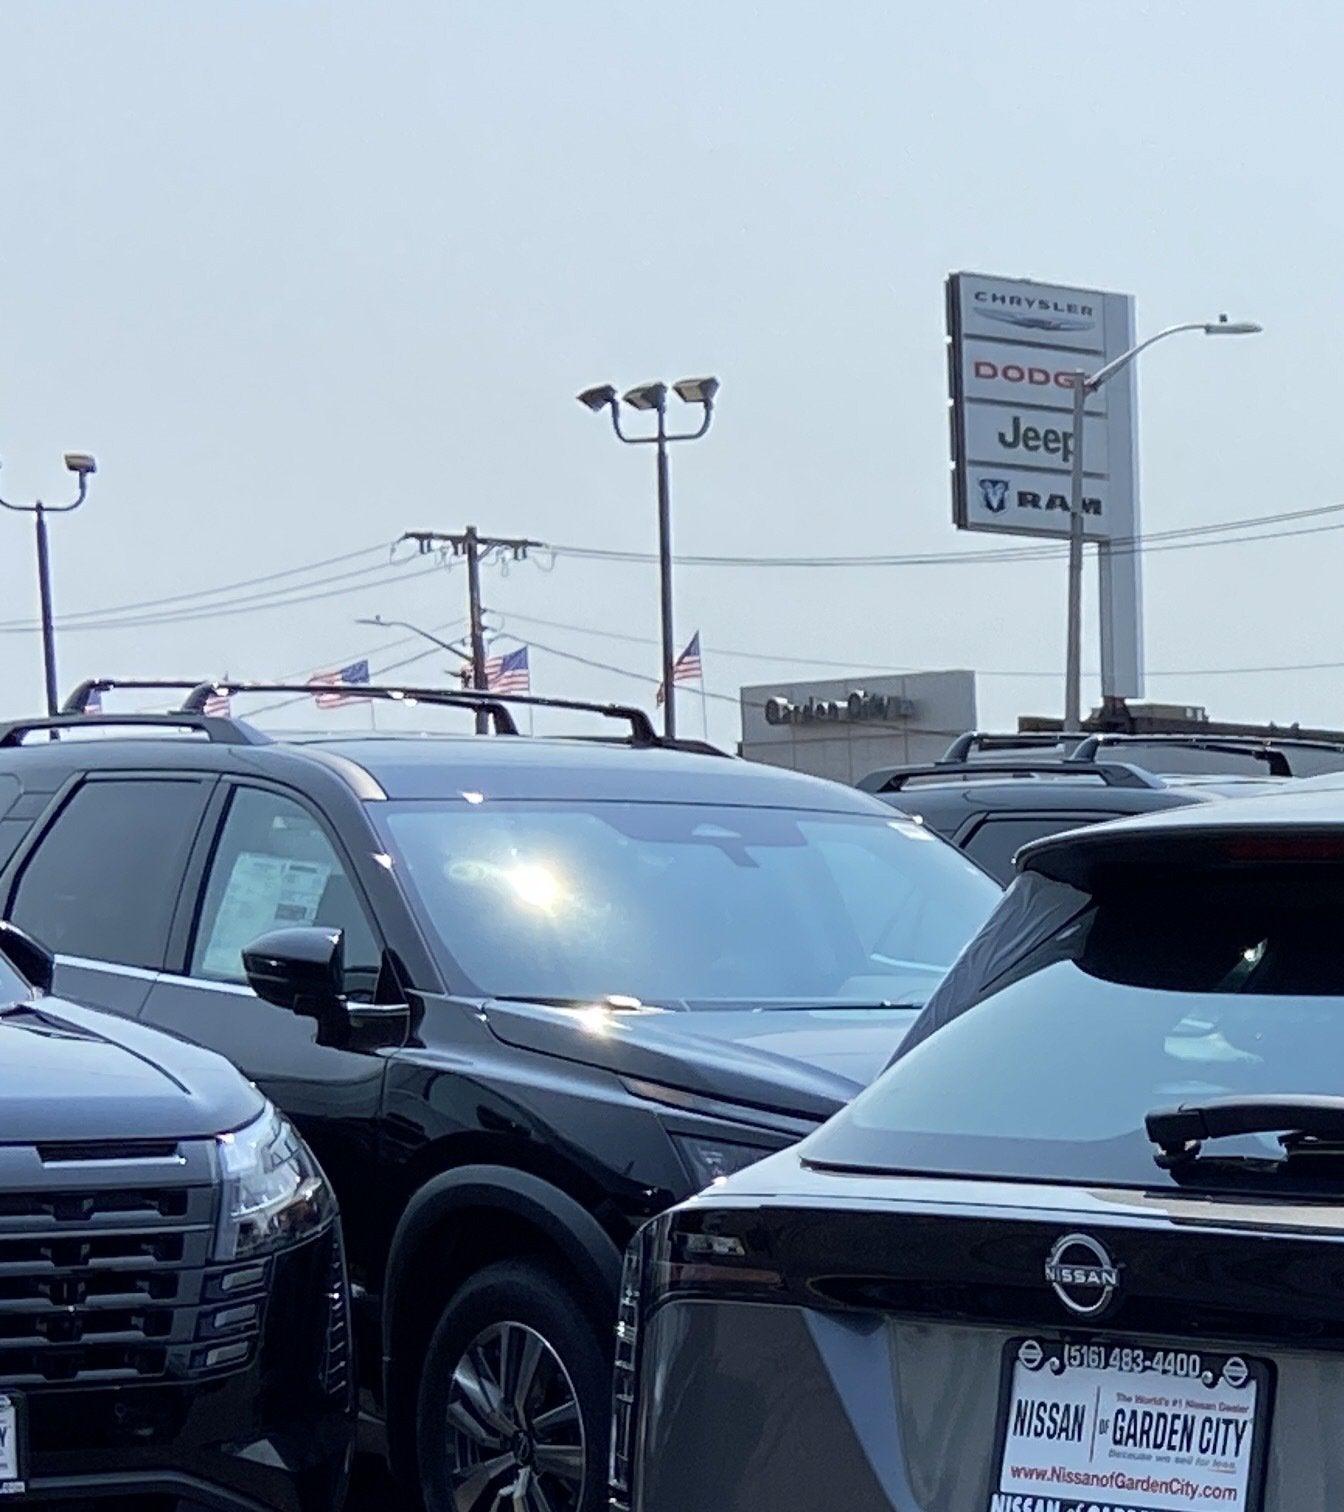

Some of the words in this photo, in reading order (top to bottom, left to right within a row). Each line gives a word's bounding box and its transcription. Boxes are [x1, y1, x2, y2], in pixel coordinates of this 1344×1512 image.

[974, 291, 1094, 317] CHRYSLER
[974, 361, 1098, 394] DODG
[1016, 490, 1103, 516] RAM
[1045, 1266, 1117, 1285] NISSAN
[1063, 1344, 1105, 1369] (516)
[1109, 1347, 1201, 1378] 483-4400
[1012, 1399, 1086, 1443] NISSAN
[1112, 1407, 1195, 1453] GARDEN
[1199, 1416, 1248, 1458] CITY
[1010, 1464, 1238, 1501] www.NissanofGardenCity.com
